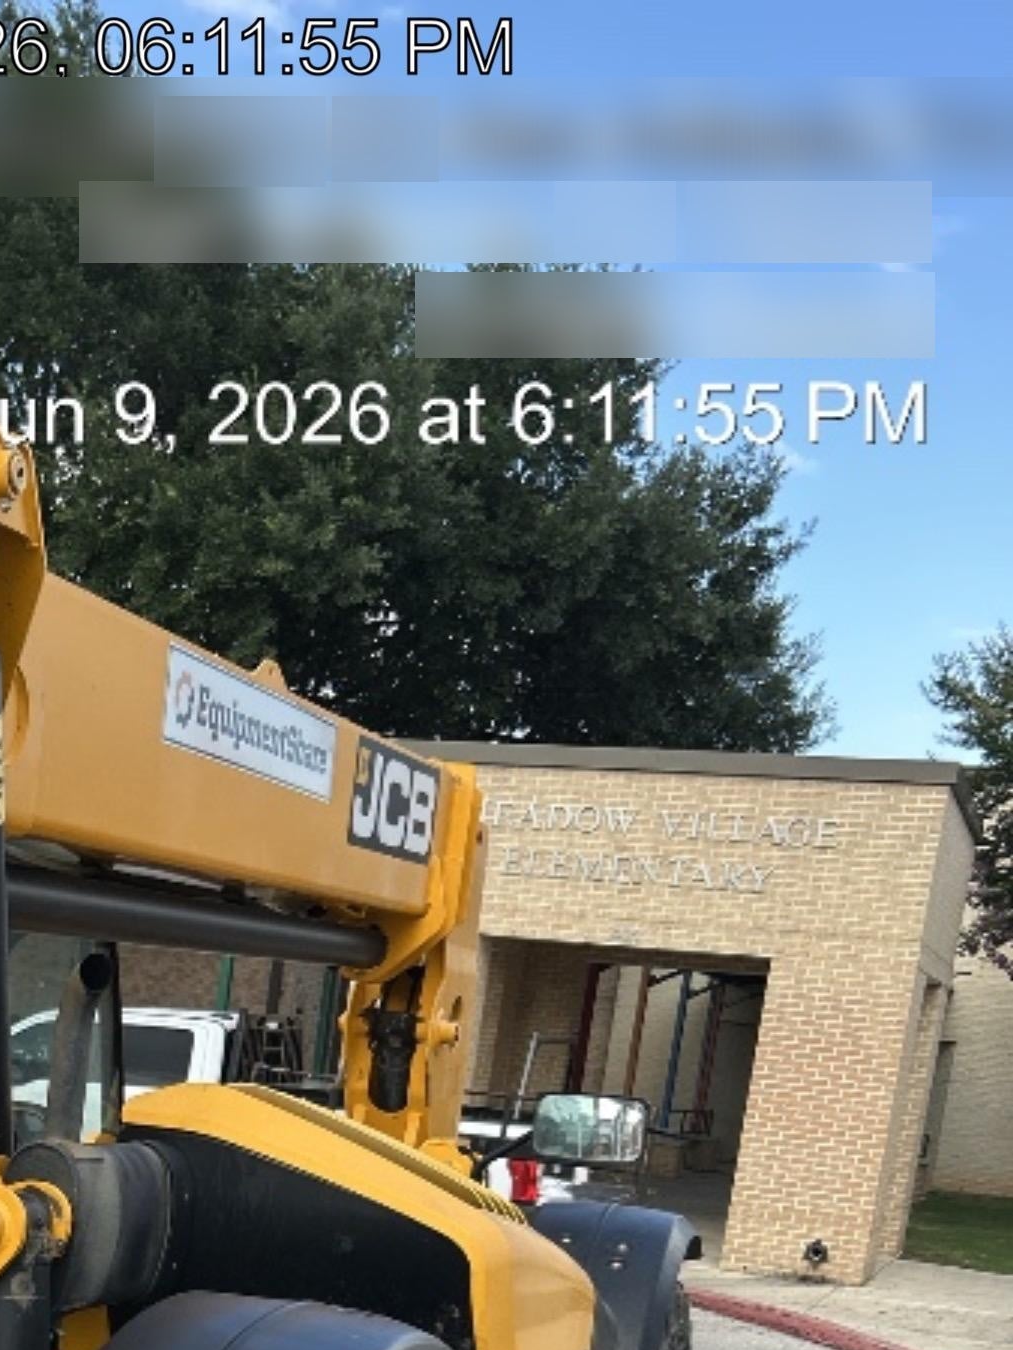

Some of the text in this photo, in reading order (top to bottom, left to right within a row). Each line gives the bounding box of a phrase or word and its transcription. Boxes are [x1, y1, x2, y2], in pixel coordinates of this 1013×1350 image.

[196, 682, 329, 775] EquipmentShare
[351, 752, 437, 857] JCB
[479, 797, 839, 849] EADOW VILLAGE
[500, 847, 775, 894] ELEMENTARY
